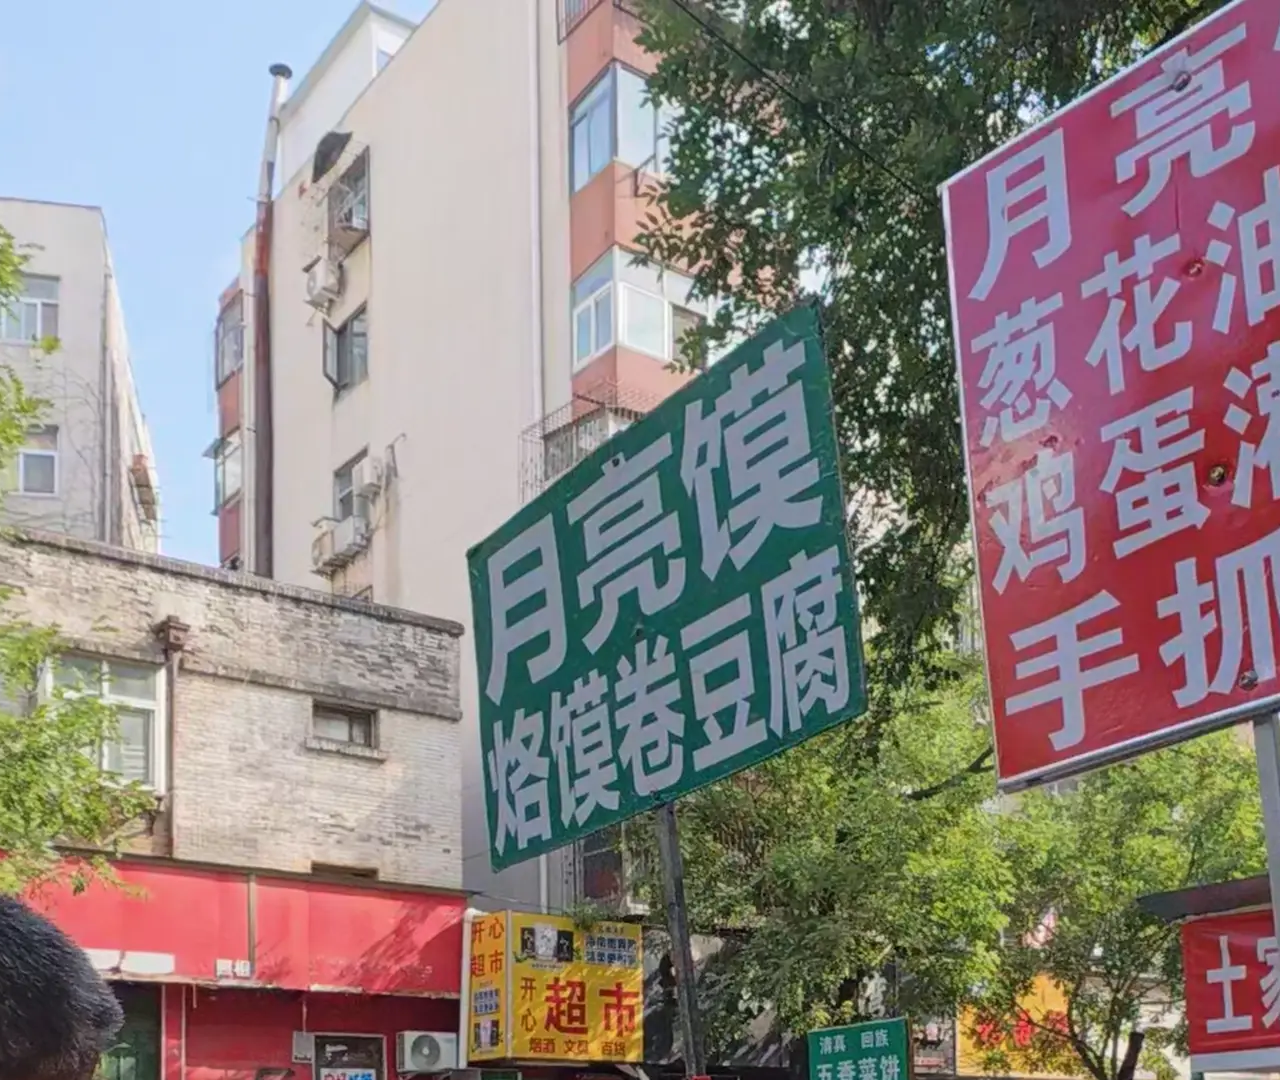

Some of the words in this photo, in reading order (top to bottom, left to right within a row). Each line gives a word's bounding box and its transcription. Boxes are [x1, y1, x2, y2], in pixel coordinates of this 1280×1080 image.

[485, 341, 823, 703] 月亮馍
[489, 546, 849, 855] 烙馍卷豆腐
[472, 917, 504, 943] 开心
[471, 950, 504, 978] 超市
[521, 977, 537, 1033] 开心
[544, 976, 639, 1037] 超市
[819, 1034, 846, 1055] 清真
[861, 1029, 889, 1049] 回族
